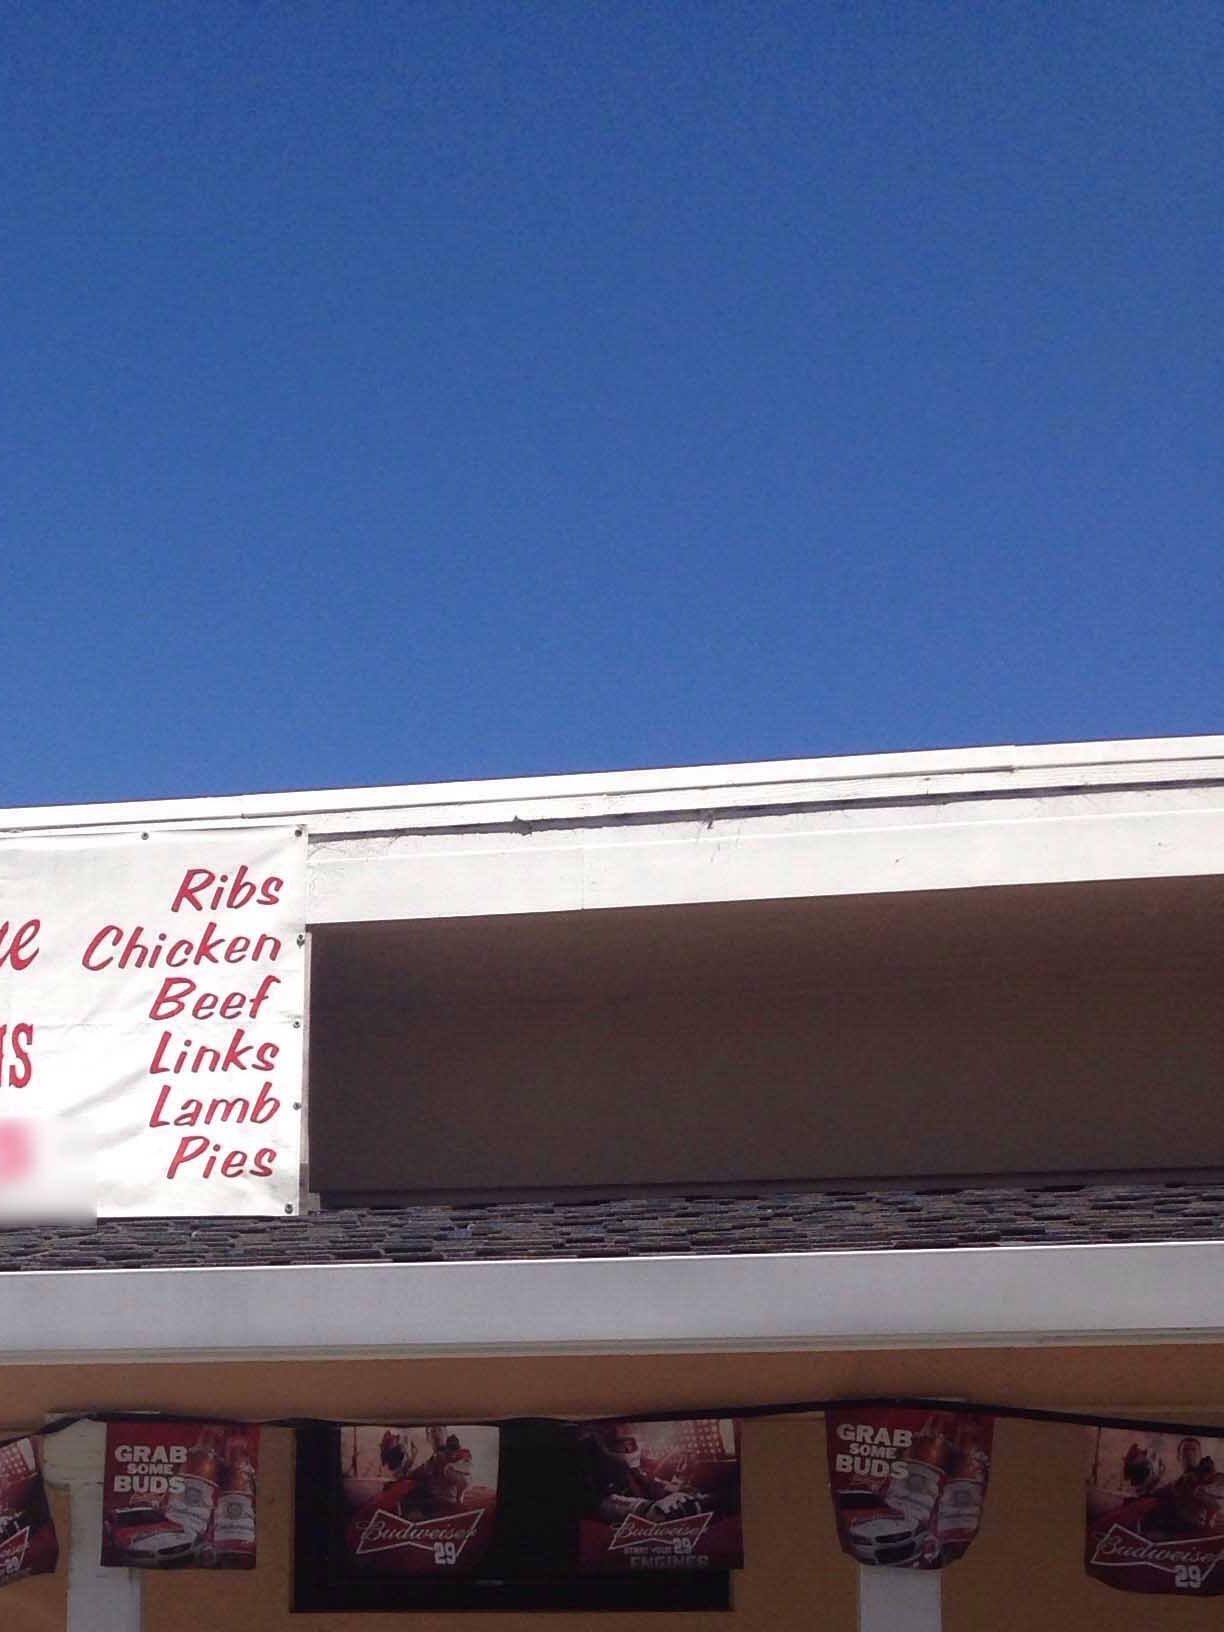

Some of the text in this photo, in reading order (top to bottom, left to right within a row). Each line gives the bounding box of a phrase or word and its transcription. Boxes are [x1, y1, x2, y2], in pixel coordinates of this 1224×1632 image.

[172, 866, 284, 912] Ribs
[82, 921, 282, 971] Chicken
[149, 975, 281, 1021] Beef
[150, 1028, 281, 1075] Links
[150, 1082, 281, 1128] Lamb
[167, 1135, 277, 1179] Pies
[836, 1423, 913, 1448] GRAB
[114, 1445, 188, 1463] GRAB
[849, 1443, 897, 1459] SOME
[126, 1462, 174, 1475] SOME
[835, 1455, 909, 1480] BUDS
[113, 1475, 187, 1494] BUDS
[355, 1521, 478, 1540] Budweiser
[608, 1521, 708, 1539] Budweiser
[434, 1542, 456, 1565] 29
